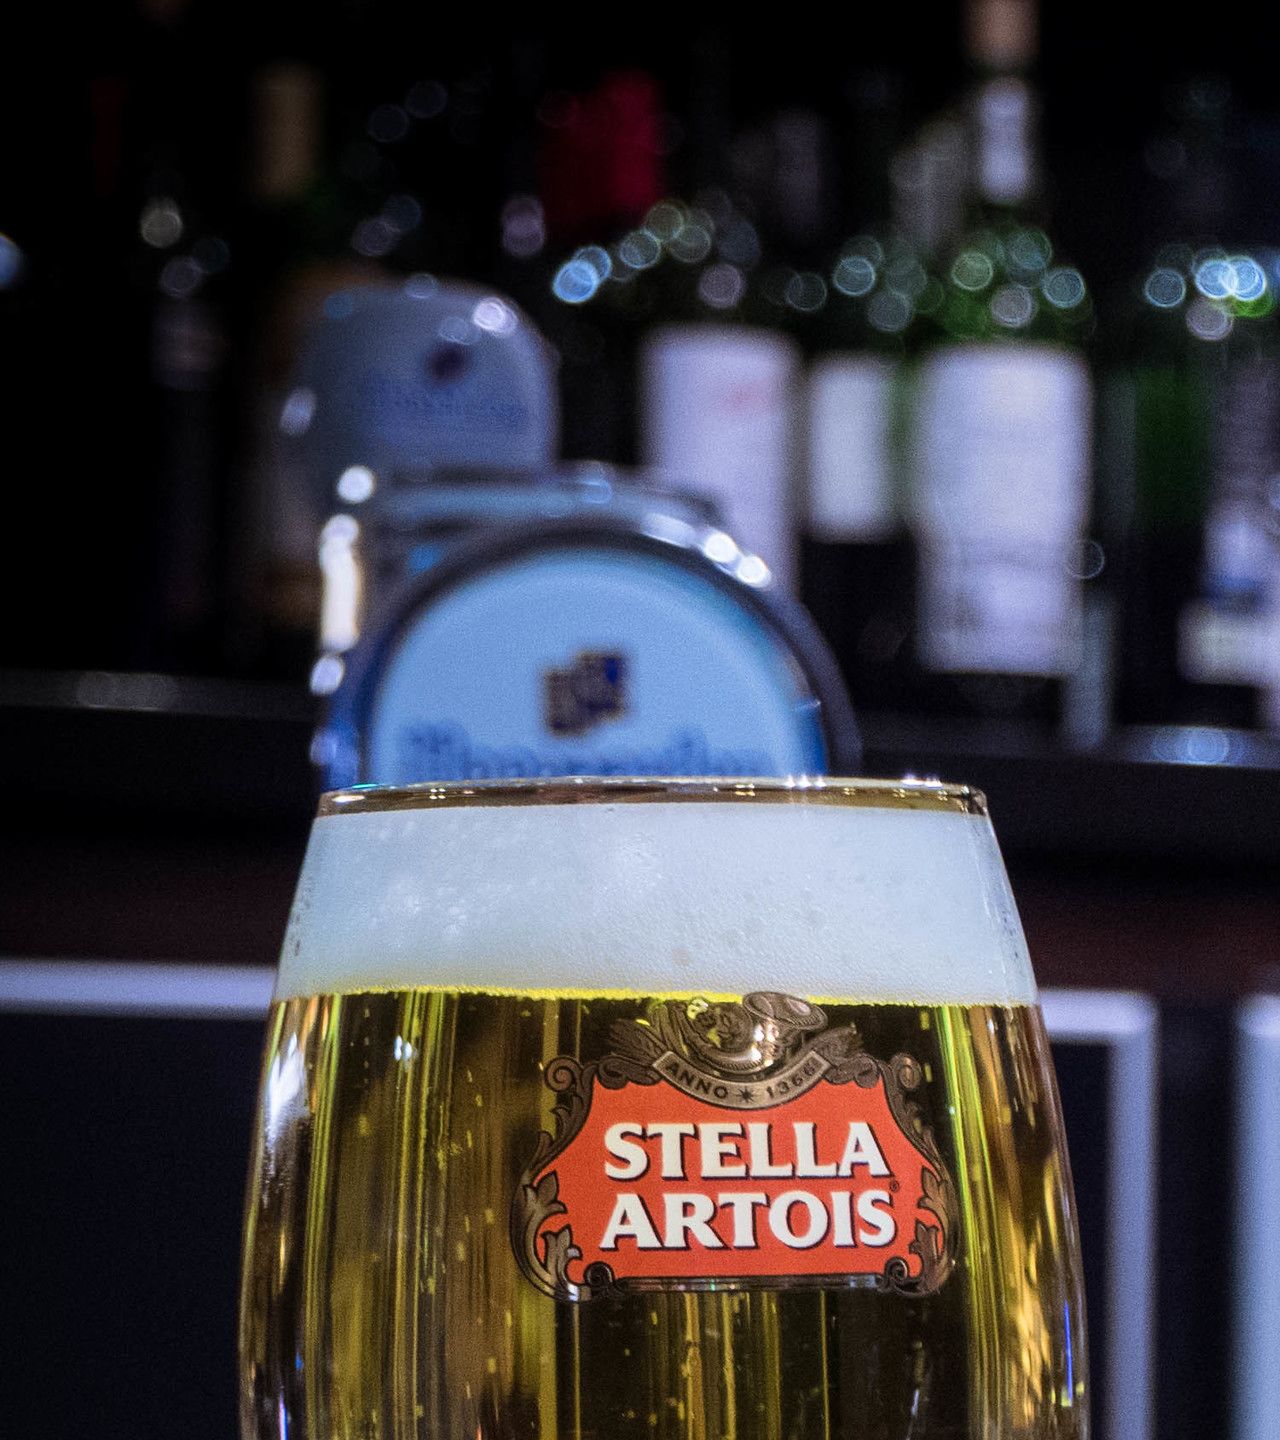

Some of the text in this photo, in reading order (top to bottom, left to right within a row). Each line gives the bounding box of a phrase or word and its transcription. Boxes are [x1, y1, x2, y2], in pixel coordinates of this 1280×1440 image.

[664, 1061, 730, 1099] ANNO
[603, 1121, 894, 1181] STELLA
[599, 1189, 897, 1250] ARTOIS
